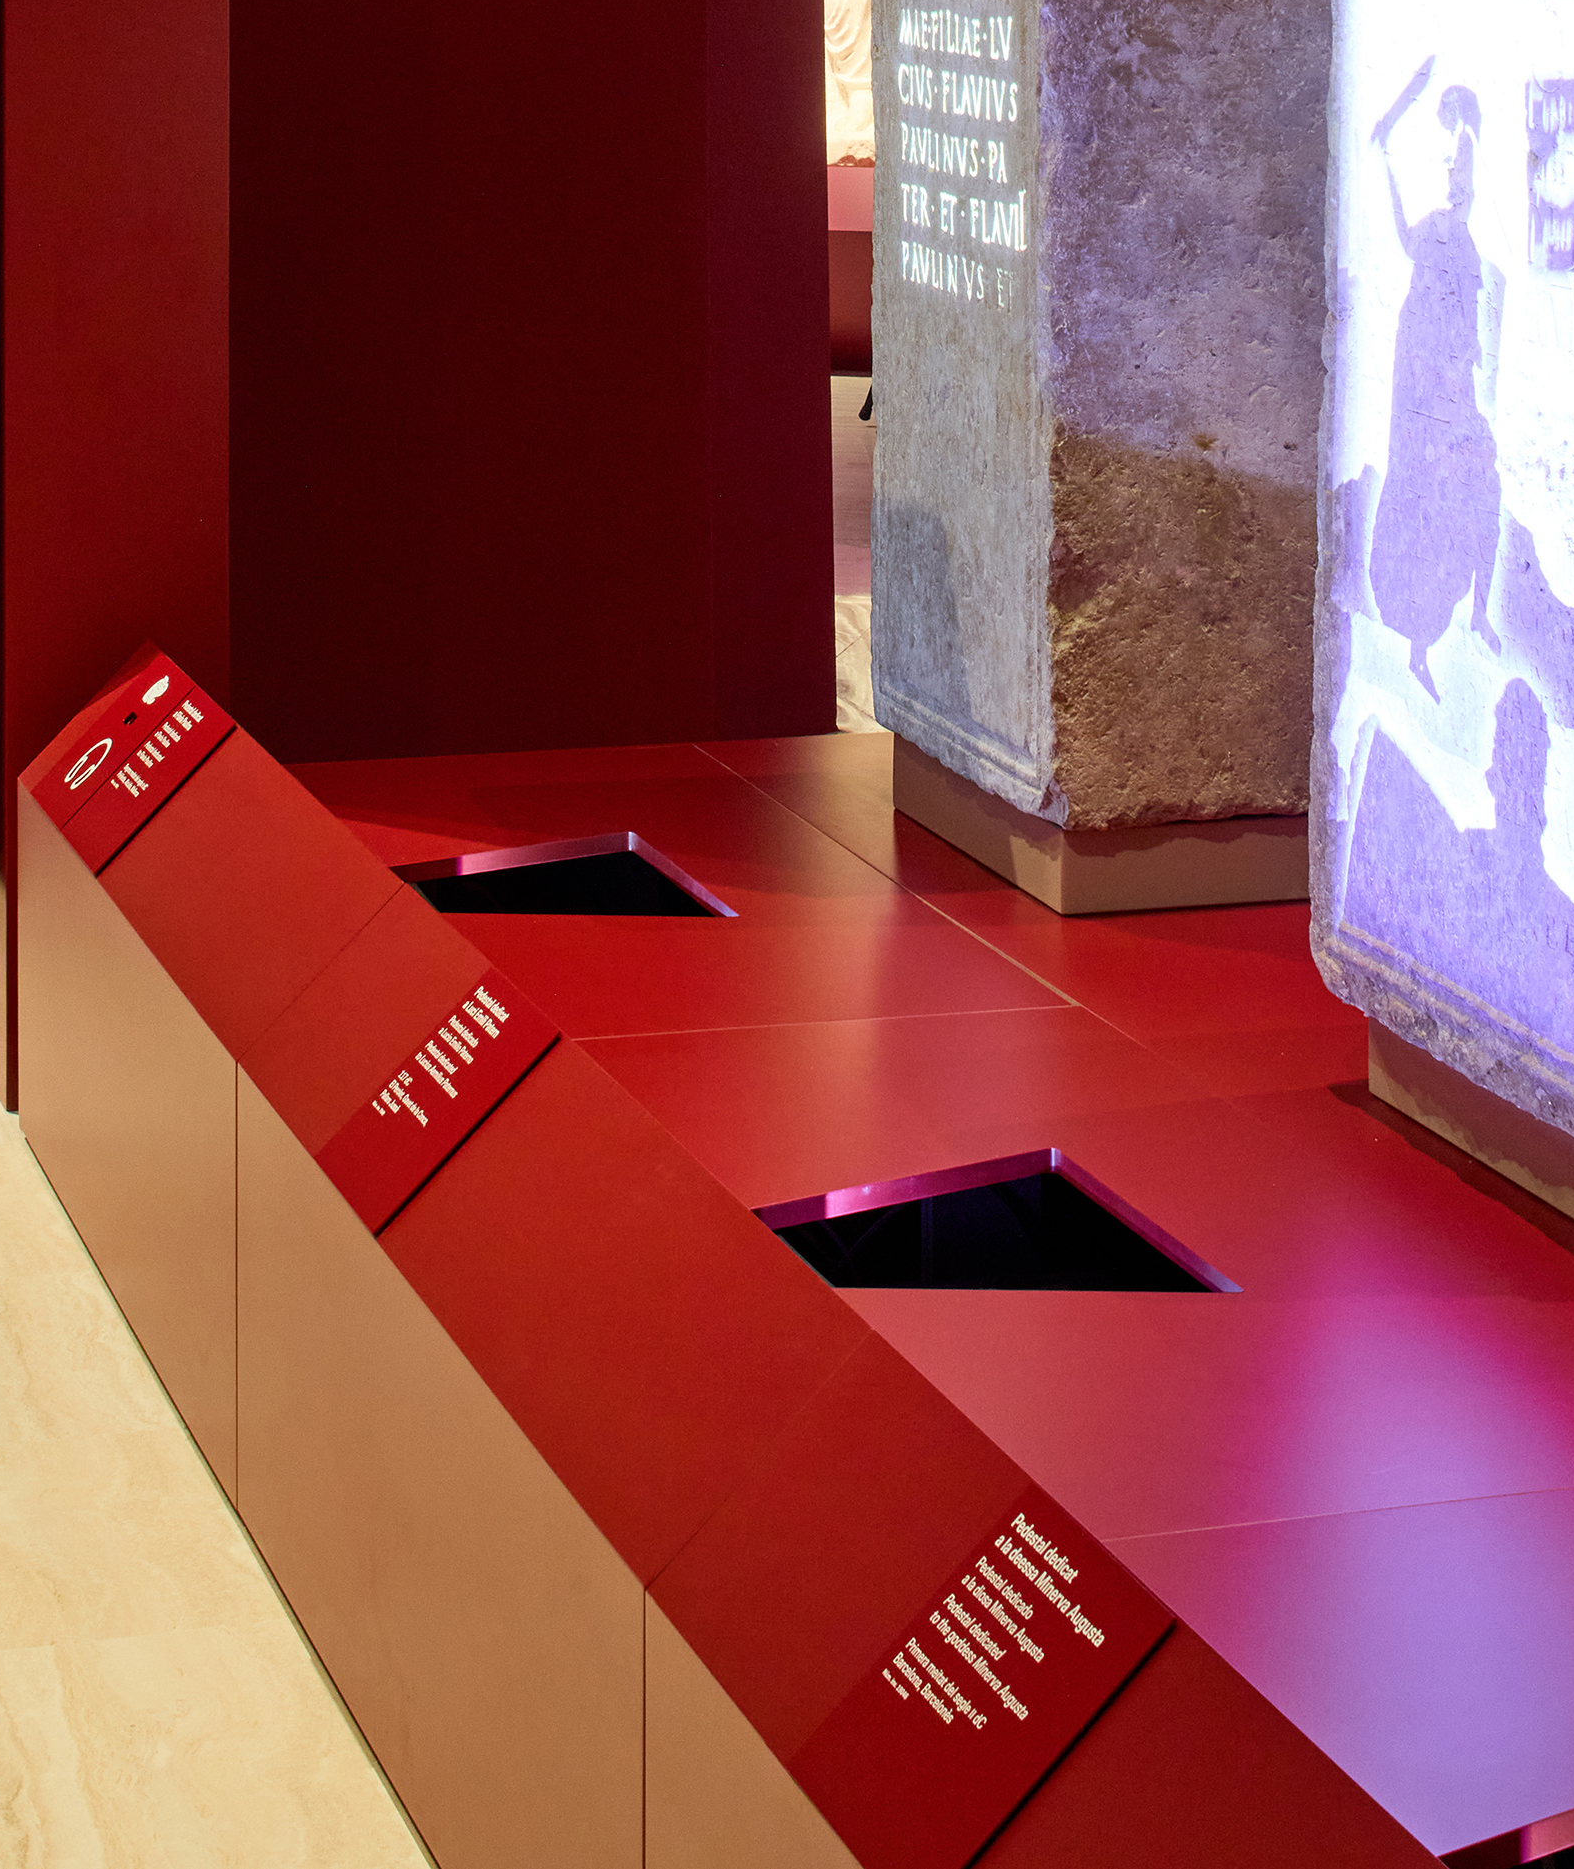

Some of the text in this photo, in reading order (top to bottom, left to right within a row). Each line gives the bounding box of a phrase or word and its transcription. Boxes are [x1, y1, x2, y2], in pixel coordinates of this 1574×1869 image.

[941, 70, 1018, 123] FLAVIVS
[901, 240, 984, 302] PAVLINVS
[1010, 1512, 1078, 1583] Pedestal dedicat
[961, 1574, 1044, 1662] a la diosa Minerva Augusta
[975, 1555, 1033, 1619] Pedestal dedicado
[994, 1534, 1104, 1647] a la deessa Minerva Augusta
[942, 1593, 1006, 1660] Pedestal dedicated
[892, 1651, 954, 1724] Barcelona, Barcelonès
[905, 1636, 930, 1668] Primera
[925, 1662, 948, 1687] meitat
[943, 1681, 959, 1697] del
[952, 1692, 971, 1714] segle
[972, 1713, 987, 1729] dC
[929, 1610, 1028, 1720] to the goddess Minerva Augusta
